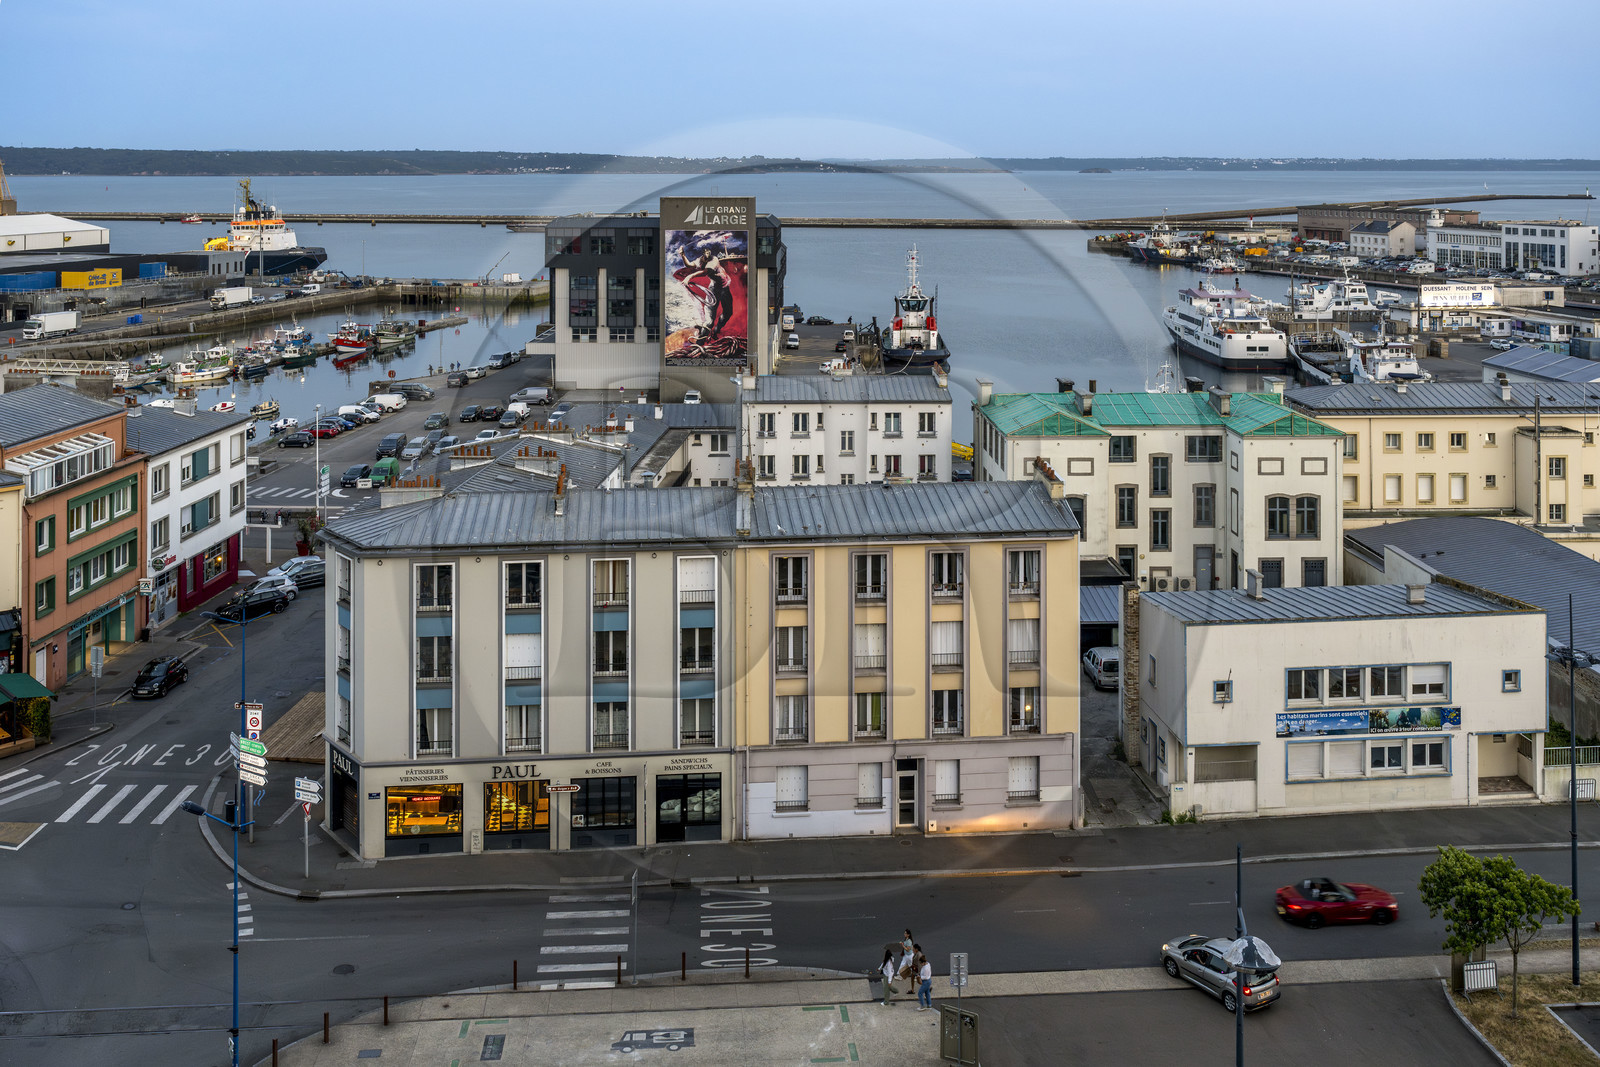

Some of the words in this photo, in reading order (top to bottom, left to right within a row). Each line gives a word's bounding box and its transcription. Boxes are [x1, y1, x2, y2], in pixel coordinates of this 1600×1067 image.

[705, 215, 746, 224] LARGE
[1287, 711, 1309, 720] habitats
[1309, 711, 1328, 719] marins
[65, 744, 185, 765] ZONE
[185, 744, 233, 766] 30
[333, 749, 354, 776] PAUL
[399, 775, 449, 783] VIENNOISERIES
[405, 768, 444, 776] PÂTISSERIES
[492, 765, 541, 779] PAUL
[701, 886, 773, 938] ZONE
[701, 943, 779, 968] 30
